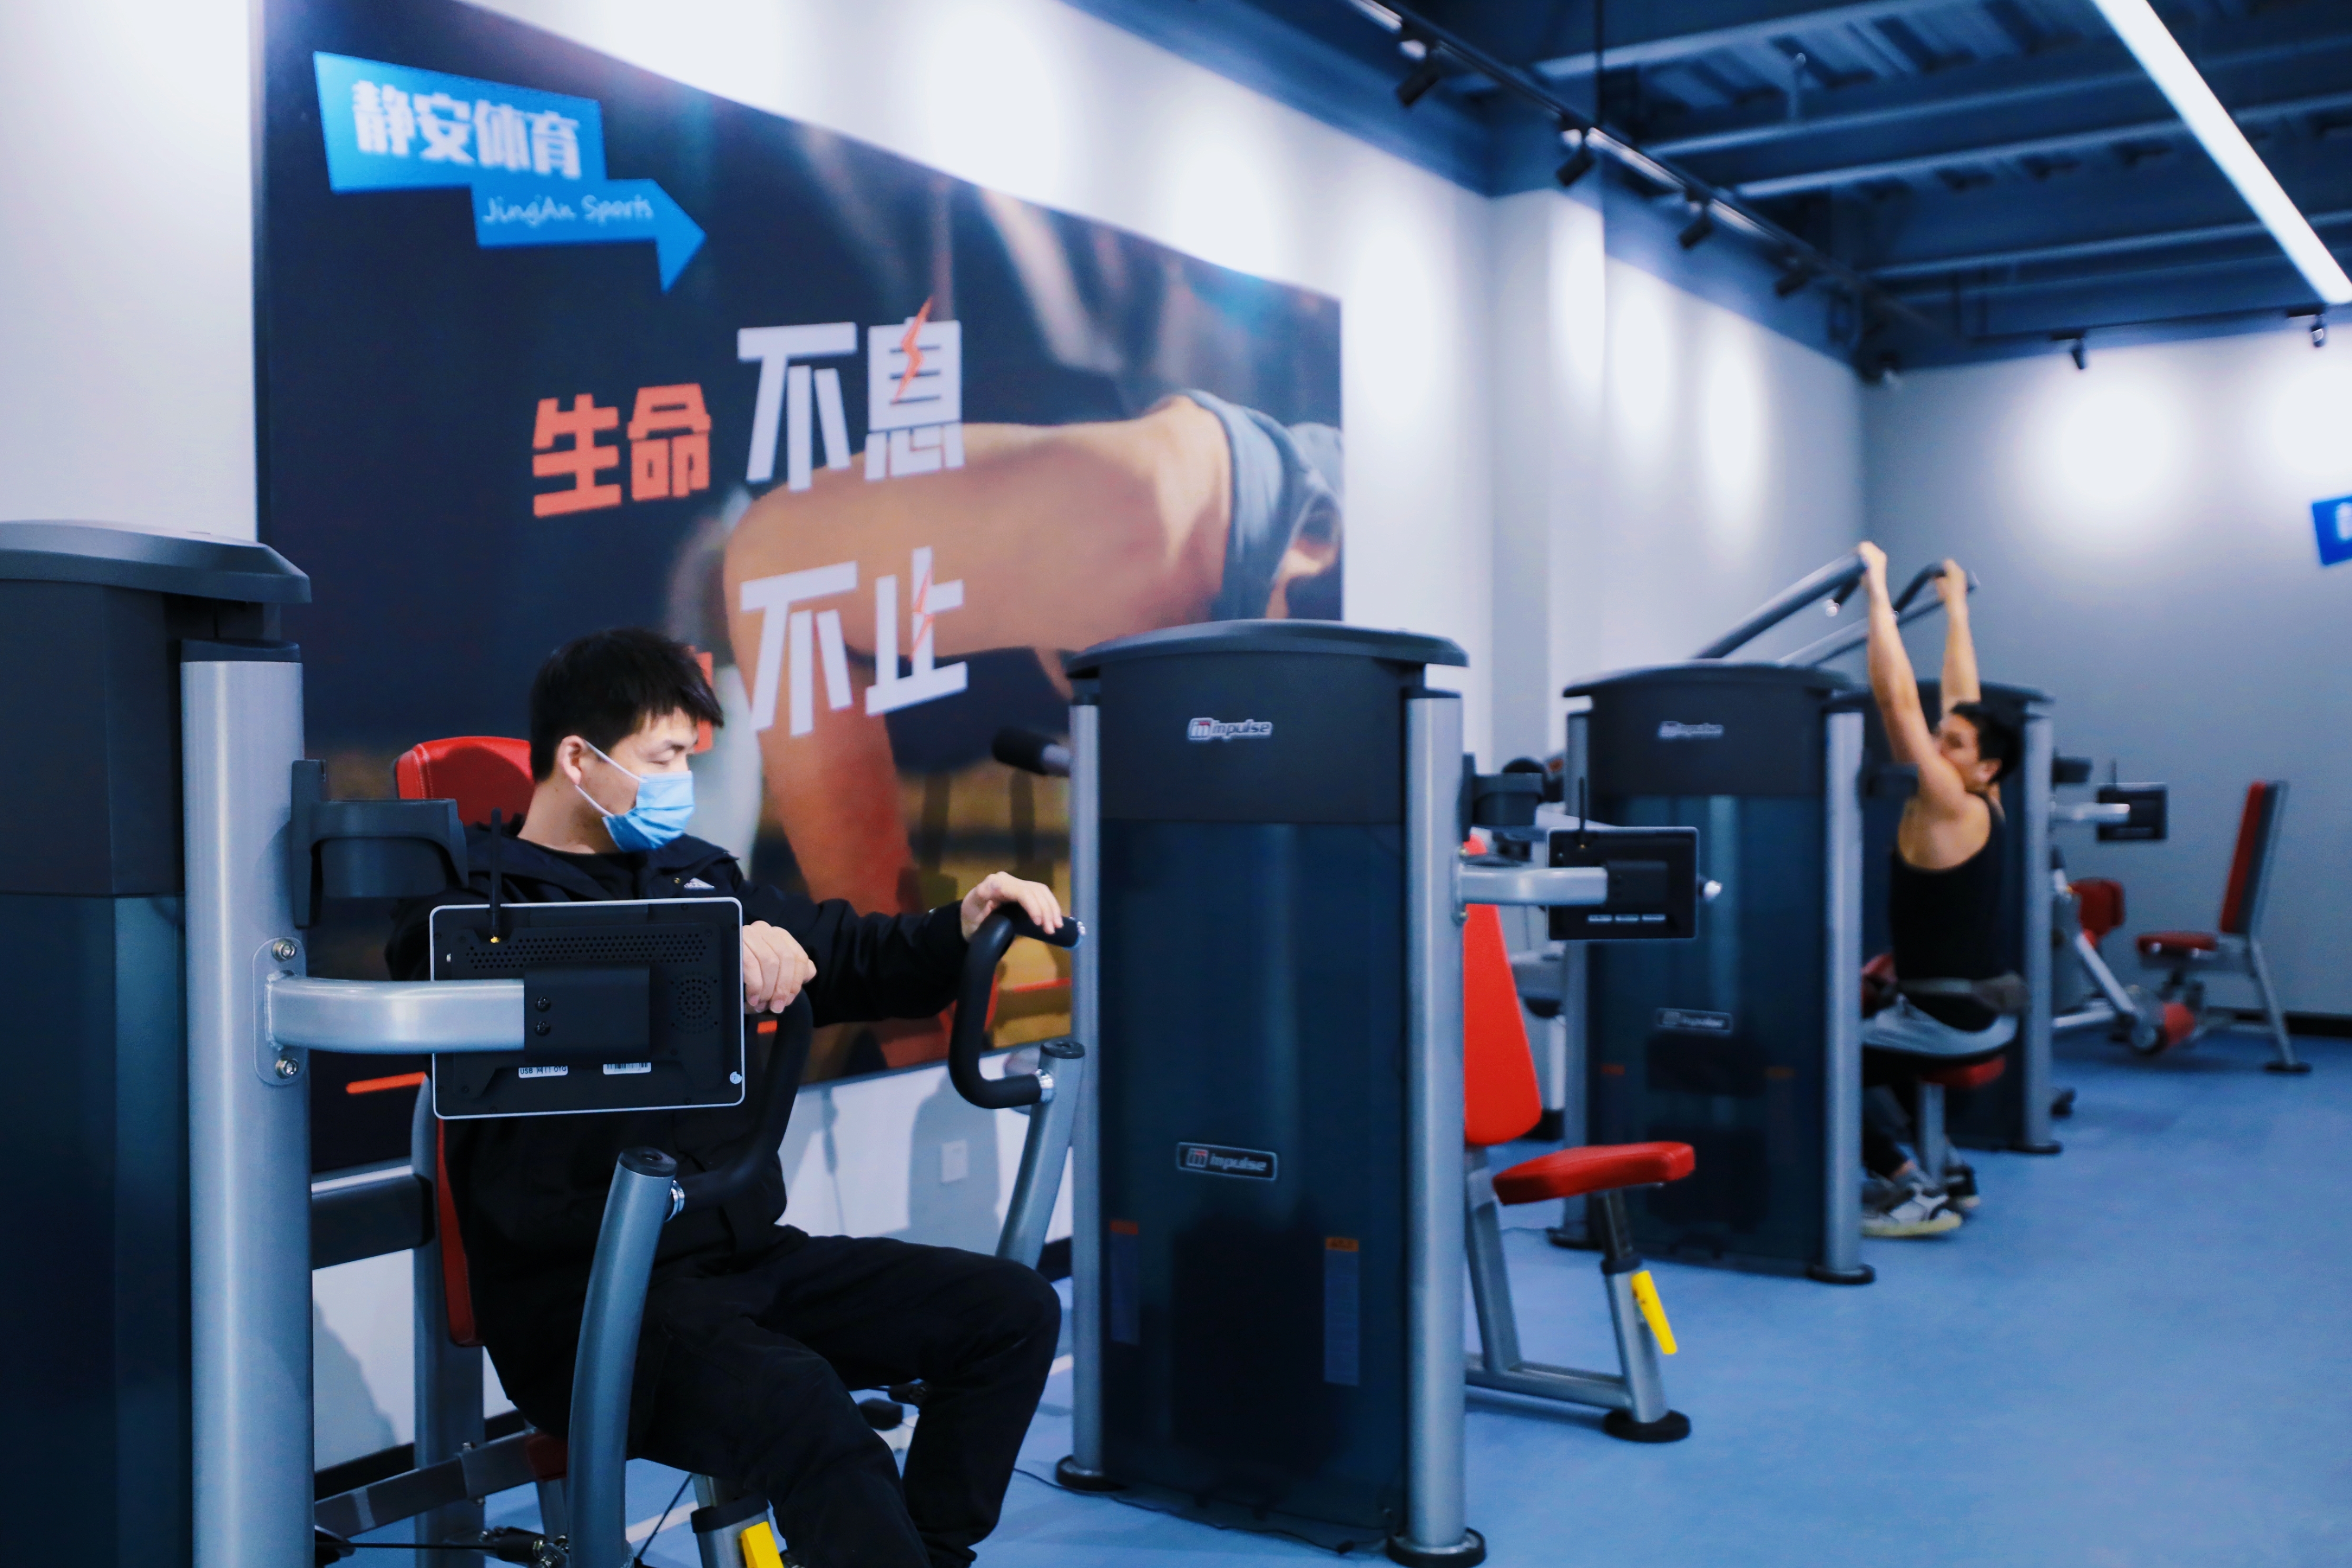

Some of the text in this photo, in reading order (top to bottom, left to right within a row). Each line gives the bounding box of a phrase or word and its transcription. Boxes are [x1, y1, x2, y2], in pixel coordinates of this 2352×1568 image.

[351, 80, 582, 179] 静安体育
[581, 194, 654, 227] Sports
[533, 316, 965, 517] 生命 不息
[740, 545, 969, 738] 不止
